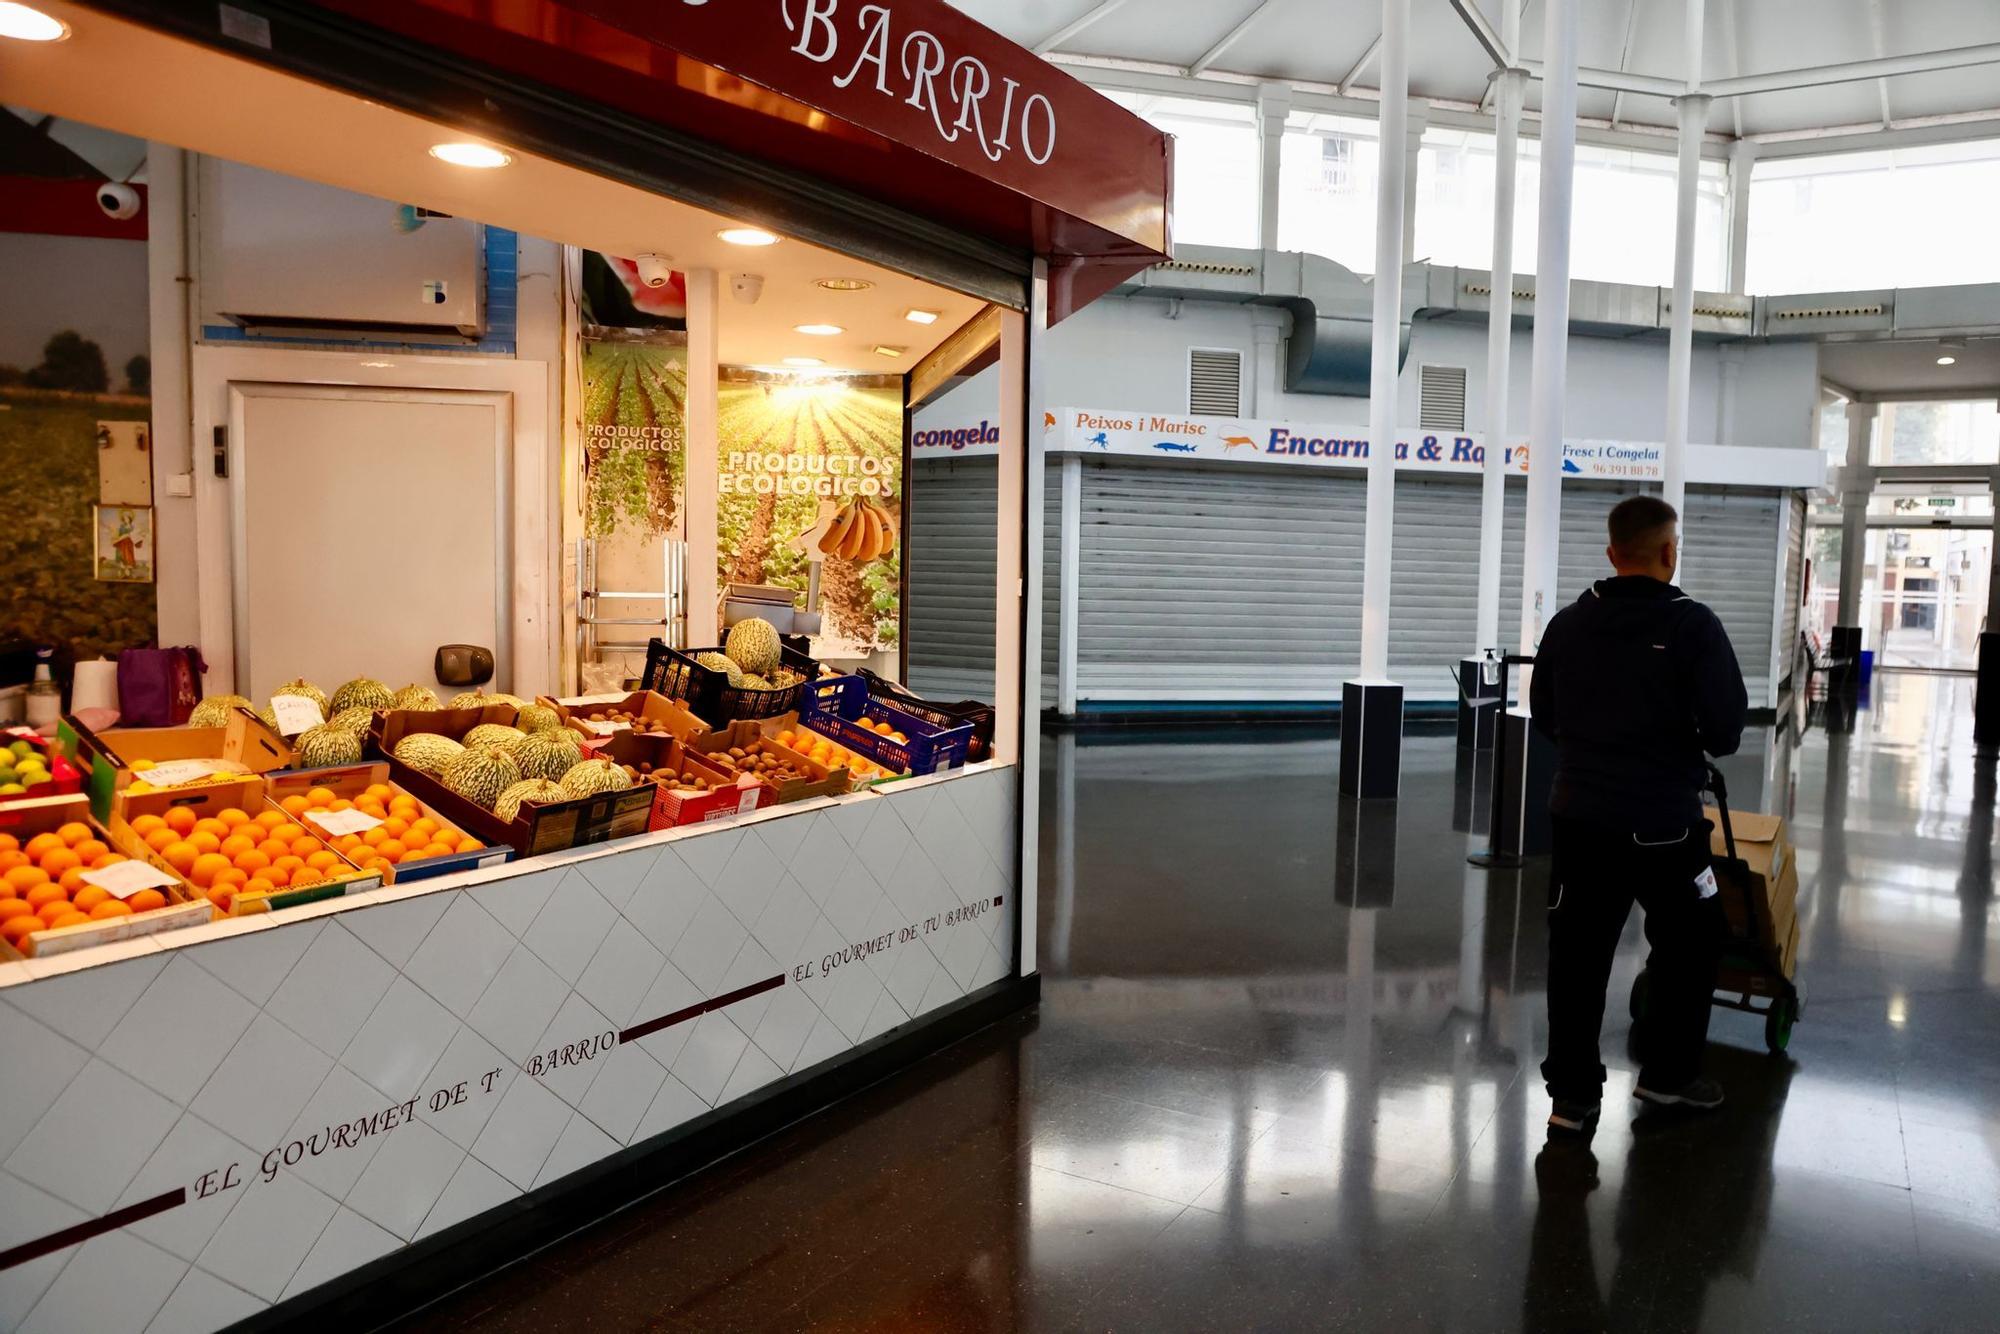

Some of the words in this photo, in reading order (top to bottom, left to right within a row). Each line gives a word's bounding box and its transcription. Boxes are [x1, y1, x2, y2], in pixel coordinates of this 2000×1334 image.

[782, 0, 1056, 165] BARRIO
[587, 425, 681, 440] PRODUCTOS
[1076, 413, 1133, 432] Peixos
[1138, 416, 1145, 432] i
[1149, 417, 1207, 435] Marisc
[1416, 435, 1443, 462] &
[1562, 444, 1595, 458] Fresc
[1606, 446, 1659, 461] Congelat
[728, 451, 894, 476] PRODUCTOS
[718, 473, 894, 498] ECOLOGICOS
[792, 961, 815, 982] EL
[821, 930, 896, 978] GOURMET
[898, 924, 918, 944] DE
[923, 914, 942, 935] TU
[944, 898, 990, 928] BARRIO
[193, 1162, 241, 1200] EL
[259, 1096, 421, 1183] GOURMET
[429, 1081, 469, 1113] DE
[526, 1030, 616, 1078] BARRIO
